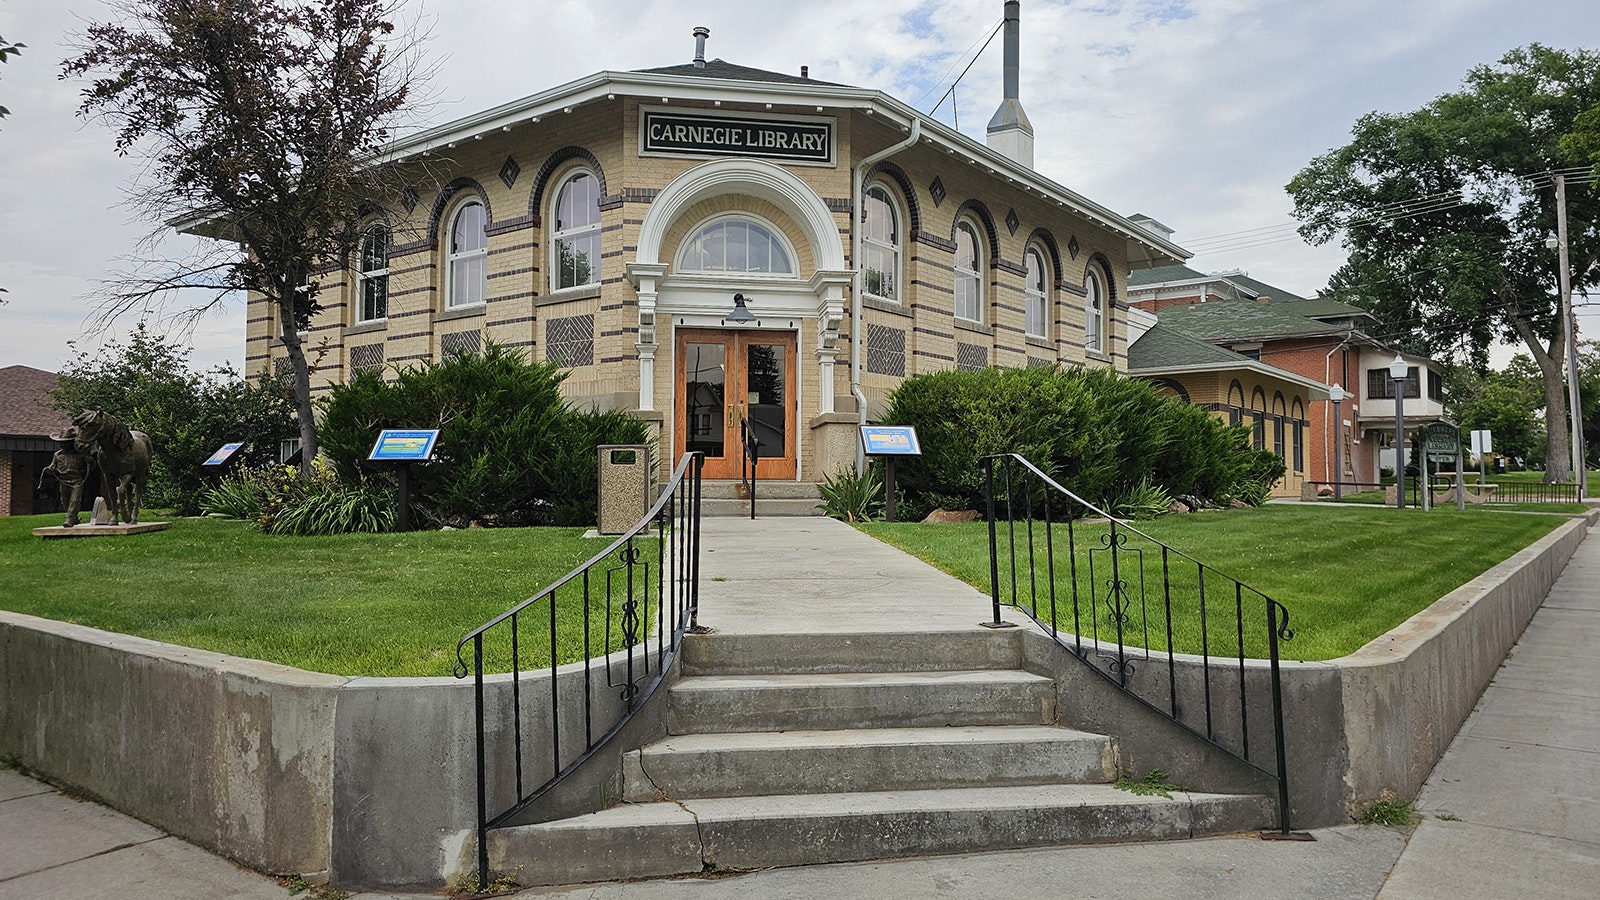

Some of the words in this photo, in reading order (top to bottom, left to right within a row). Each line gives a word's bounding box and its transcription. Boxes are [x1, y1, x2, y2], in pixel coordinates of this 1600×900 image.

[650, 123, 742, 146] CARNEGIE
[746, 129, 826, 151] LIBRARY
[1427, 442, 1455, 450] LIBRARY
